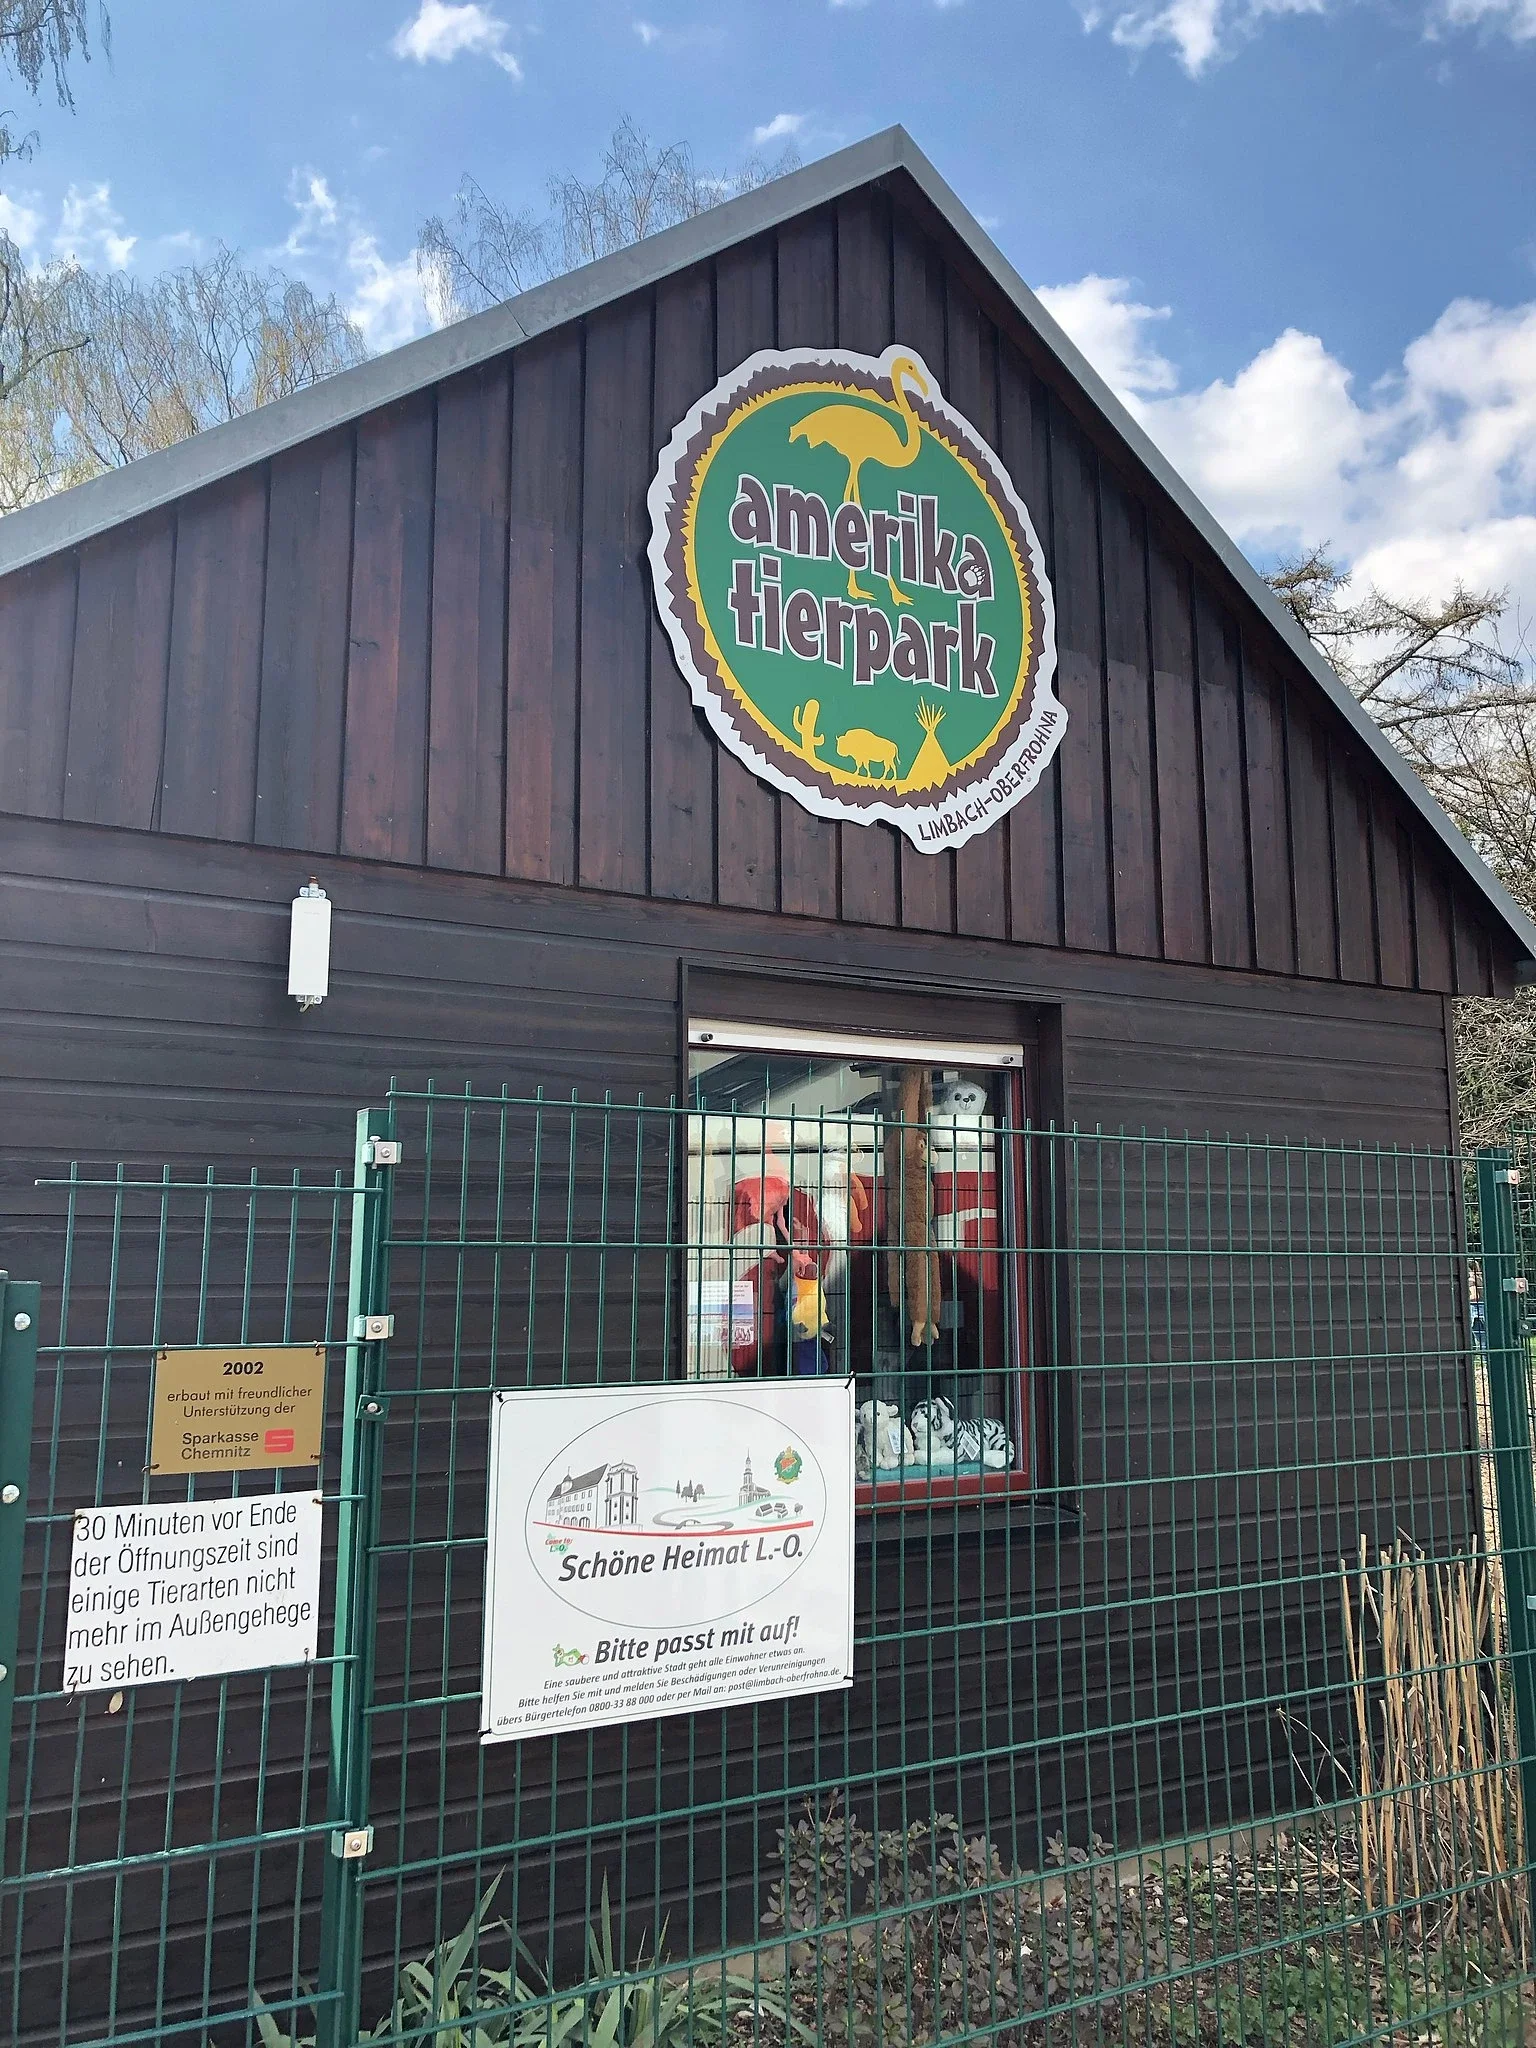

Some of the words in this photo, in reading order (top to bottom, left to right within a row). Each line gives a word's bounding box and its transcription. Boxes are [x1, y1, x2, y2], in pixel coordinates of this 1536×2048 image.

[728, 473, 995, 601] amerika
[728, 552, 1000, 699] tierpark
[917, 709, 1058, 841] LIMBACH-OBERFROHNA
[222, 1361, 264, 1376] 2002
[167, 1389, 211, 1402] erbaut
[214, 1387, 234, 1400] mit
[238, 1385, 313, 1399] freundlicher
[183, 1404, 270, 1418] Unterstützung
[274, 1402, 296, 1414] der
[181, 1446, 251, 1460] Chemnitz
[182, 1431, 259, 1447] Sparkasse
[76, 1515, 106, 1542] 30
[115, 1512, 205, 1539] Minuten
[211, 1509, 243, 1531] vor
[250, 1501, 297, 1527] Ende
[74, 1552, 111, 1577] der
[118, 1537, 251, 1573] Öffnungszeit
[257, 1532, 299, 1560] sind
[558, 1550, 655, 1582] Schöne
[662, 1537, 750, 1571] Heimat
[755, 1533, 803, 1561] L.-O.
[72, 1584, 140, 1614] einige
[148, 1576, 239, 1606] Tierarten
[246, 1567, 296, 1595] nicht
[68, 1621, 128, 1650] mehr
[135, 1617, 162, 1642] im
[169, 1601, 311, 1639] Außengehege
[594, 1637, 649, 1664] Bitte
[653, 1628, 715, 1662] passt
[720, 1622, 755, 1647] mit
[760, 1615, 801, 1645] auf!
[66, 1663, 92, 1687] zu
[100, 1653, 175, 1681] sehen.
[518, 1697, 540, 1708] Bitte
[541, 1692, 570, 1706] helfen
[571, 1690, 585, 1700] Sie
[587, 1687, 602, 1699] mit
[604, 1684, 621, 1696] und
[622, 1679, 655, 1693] melden
[656, 1677, 669, 1688] Sie
[671, 1669, 737, 1686] Beschädigungen
[738, 1665, 757, 1677] oder
[758, 1656, 826, 1673] Verunreinigungen
[543, 1680, 563, 1690] Eine
[565, 1674, 601, 1687] saubere
[602, 1670, 619, 1682] und
[621, 1665, 663, 1678] attraktive
[664, 1661, 687, 1673] Stadt
[688, 1658, 707, 1671] geht
[708, 1656, 723, 1667] alle
[725, 1651, 767, 1665] Einwohner
[768, 1648, 792, 1659] etwas
[793, 1646, 805, 1655] an.
[497, 1715, 523, 1727] übers
[525, 1704, 587, 1722] Bürgertelefon
[588, 1699, 624, 1713] 0800-33
[625, 1697, 637, 1707] 88
[638, 1694, 655, 1705] 000
[656, 1691, 676, 1703] oder
[676, 1690, 691, 1702] per
[692, 1685, 712, 1697] Mail
[713, 1684, 726, 1695] an:
[727, 1667, 842, 1694] post@limbach-oberfrohna.de.
